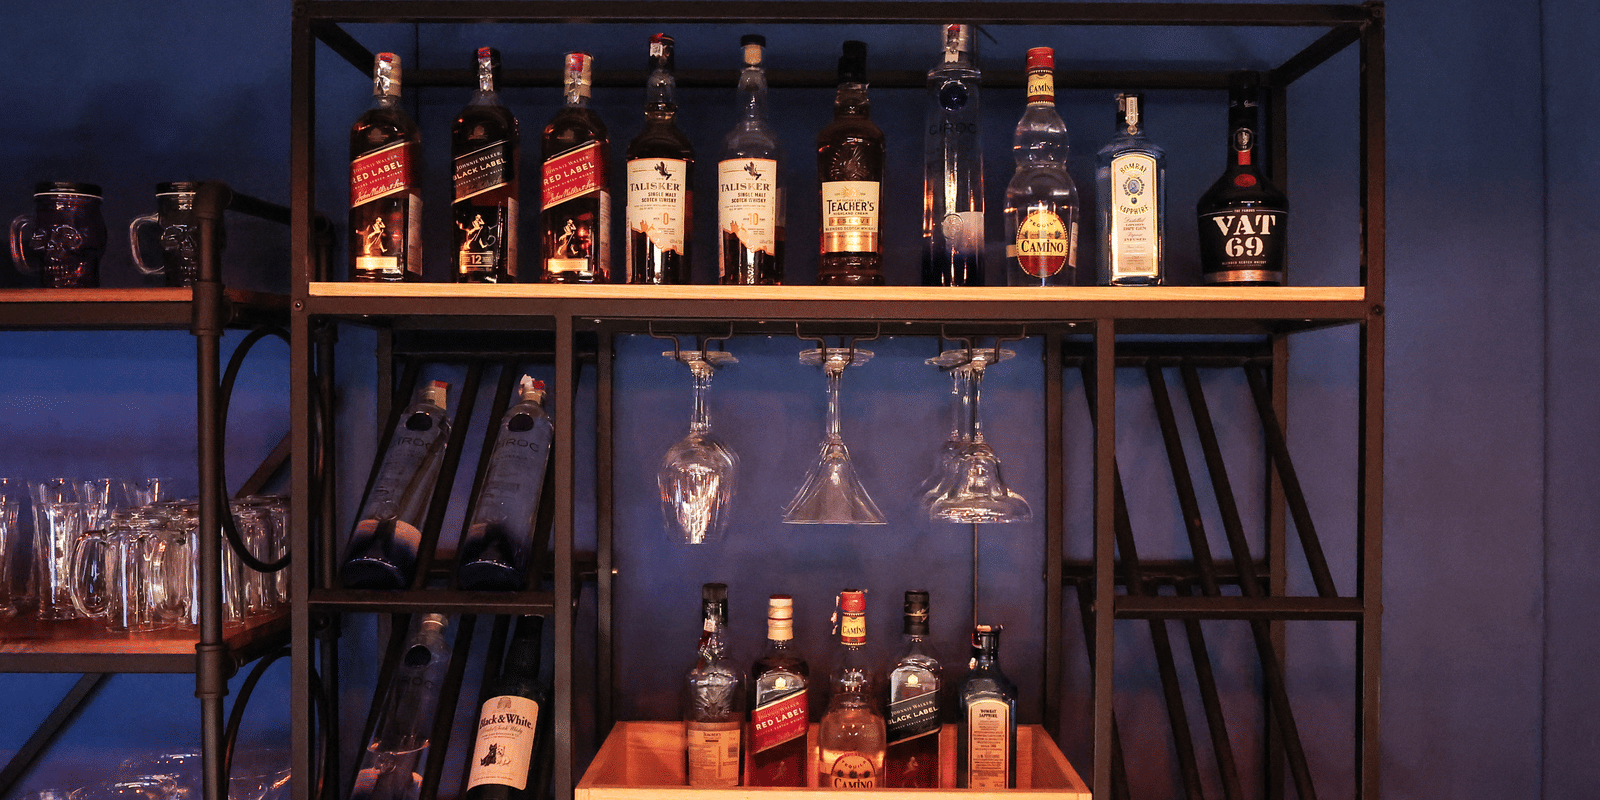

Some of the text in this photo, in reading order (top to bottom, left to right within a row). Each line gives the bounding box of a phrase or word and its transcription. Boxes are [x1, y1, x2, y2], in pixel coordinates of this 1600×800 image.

[371, 160, 403, 177] LABEL
[452, 167, 478, 181] BLACK
[480, 158, 507, 171] LABEL
[456, 152, 502, 172] JOHNNIE WALKER
[543, 161, 595, 186] RED LABEL
[630, 181, 680, 191] TALISKER
[721, 182, 770, 192] TALISKER
[826, 199, 875, 215] TEACHER'S
[747, 212, 759, 225] 10
[1212, 214, 1277, 237] VAT
[1021, 239, 1064, 253] CAMINO
[1225, 236, 1264, 258] 69
[471, 254, 482, 265] 12
[755, 720, 774, 731] RED
[775, 707, 805, 723] LABEL
[887, 713, 912, 725] BLACK
[912, 706, 938, 718] LABEL
[834, 777, 873, 789] CAMINO
